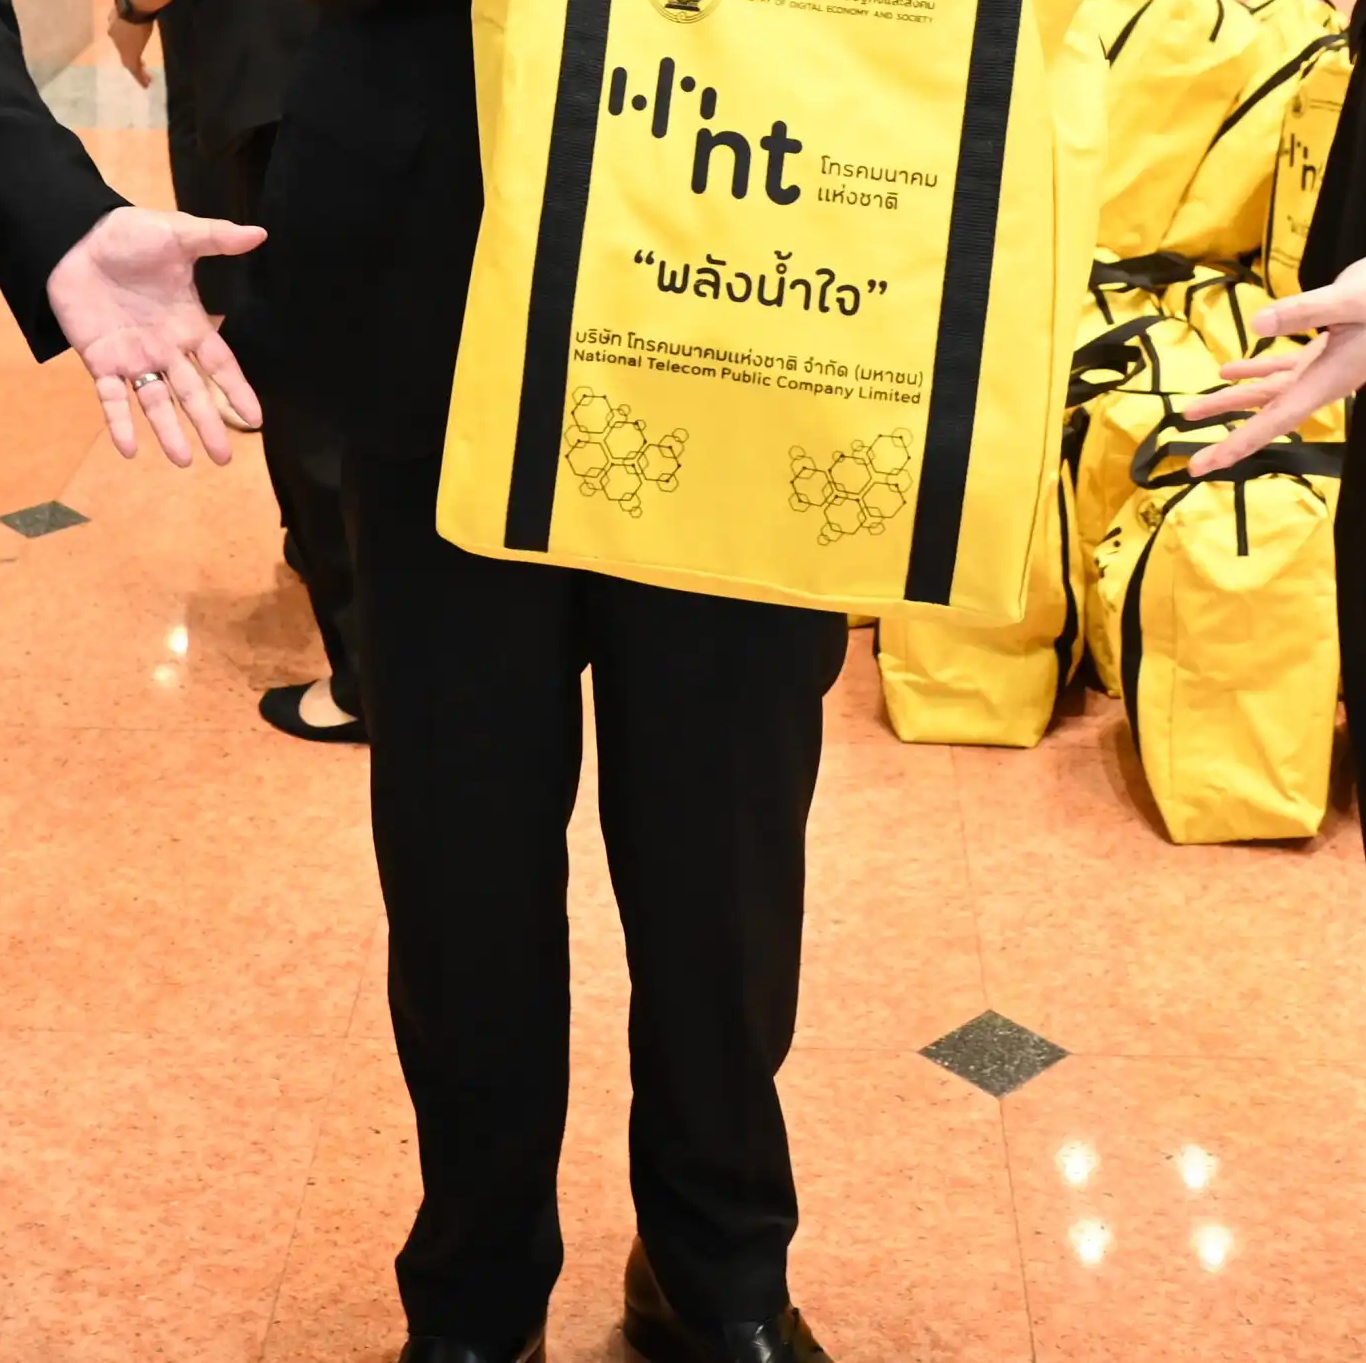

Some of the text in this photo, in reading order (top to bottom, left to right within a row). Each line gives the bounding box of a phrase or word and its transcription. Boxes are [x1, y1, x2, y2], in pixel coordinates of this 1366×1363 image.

[789, 1, 823, 13] DIGITAL
[826, 5, 869, 17] ECONOMY
[874, 10, 893, 20] AND
[896, 12, 933, 24] SOCIETY
[691, 120, 803, 206] nt
[820, 155, 938, 188] โทรคมนาคม
[817, 184, 899, 211] แห่งชาติ
[633, 249, 889, 317] “พลังน้ำใจ”
[573, 349, 922, 405] National Telecom Public Company Limited
[575, 328, 924, 388] บริษัท โทรคมนาคมแห่งชาติ จำกัด (มหาชน)
